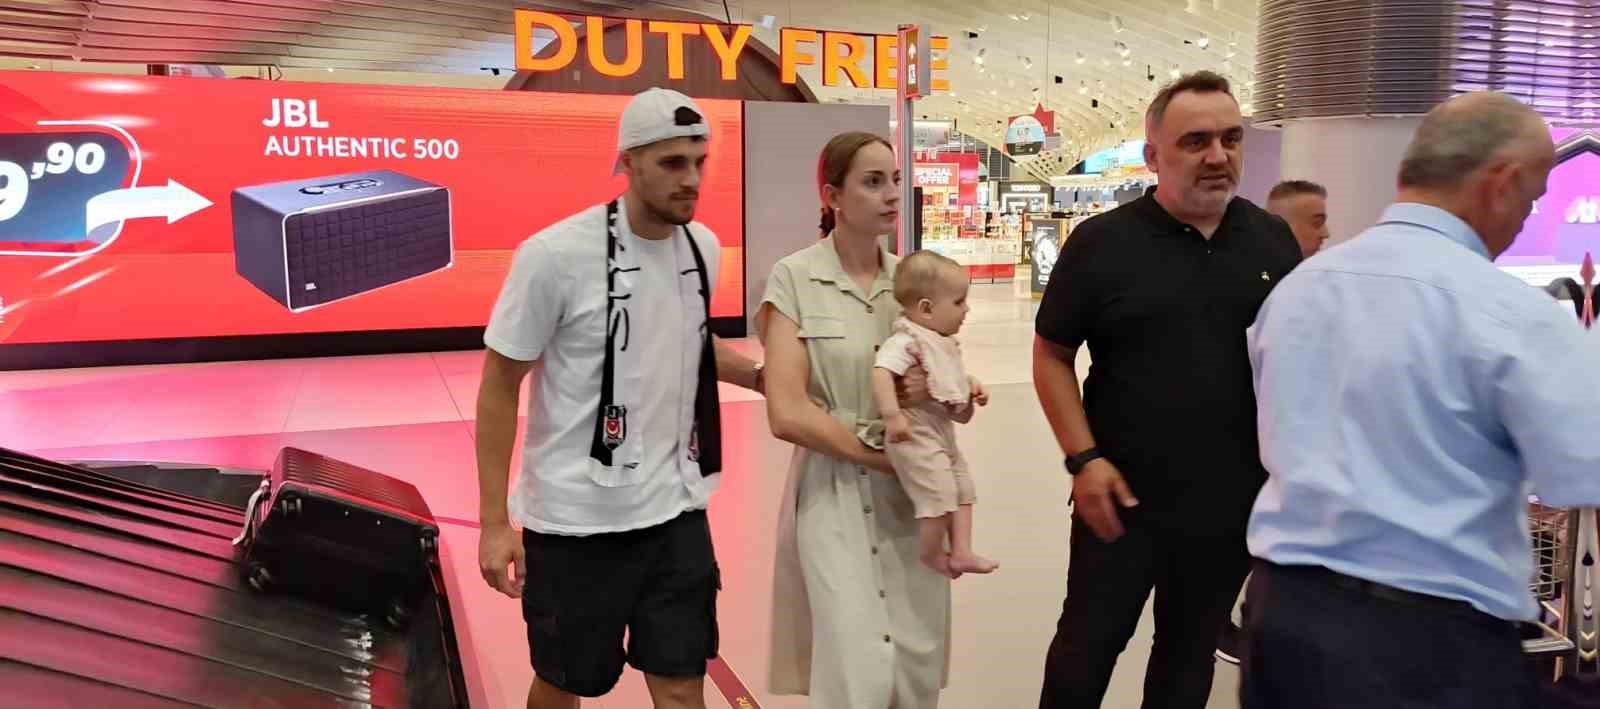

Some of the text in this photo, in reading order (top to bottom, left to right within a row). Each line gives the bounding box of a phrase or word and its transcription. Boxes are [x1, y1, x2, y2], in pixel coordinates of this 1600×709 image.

[514, 9, 752, 80] DUTY
[262, 98, 330, 128] JBL
[264, 135, 460, 160] AUTHENTIC 500
